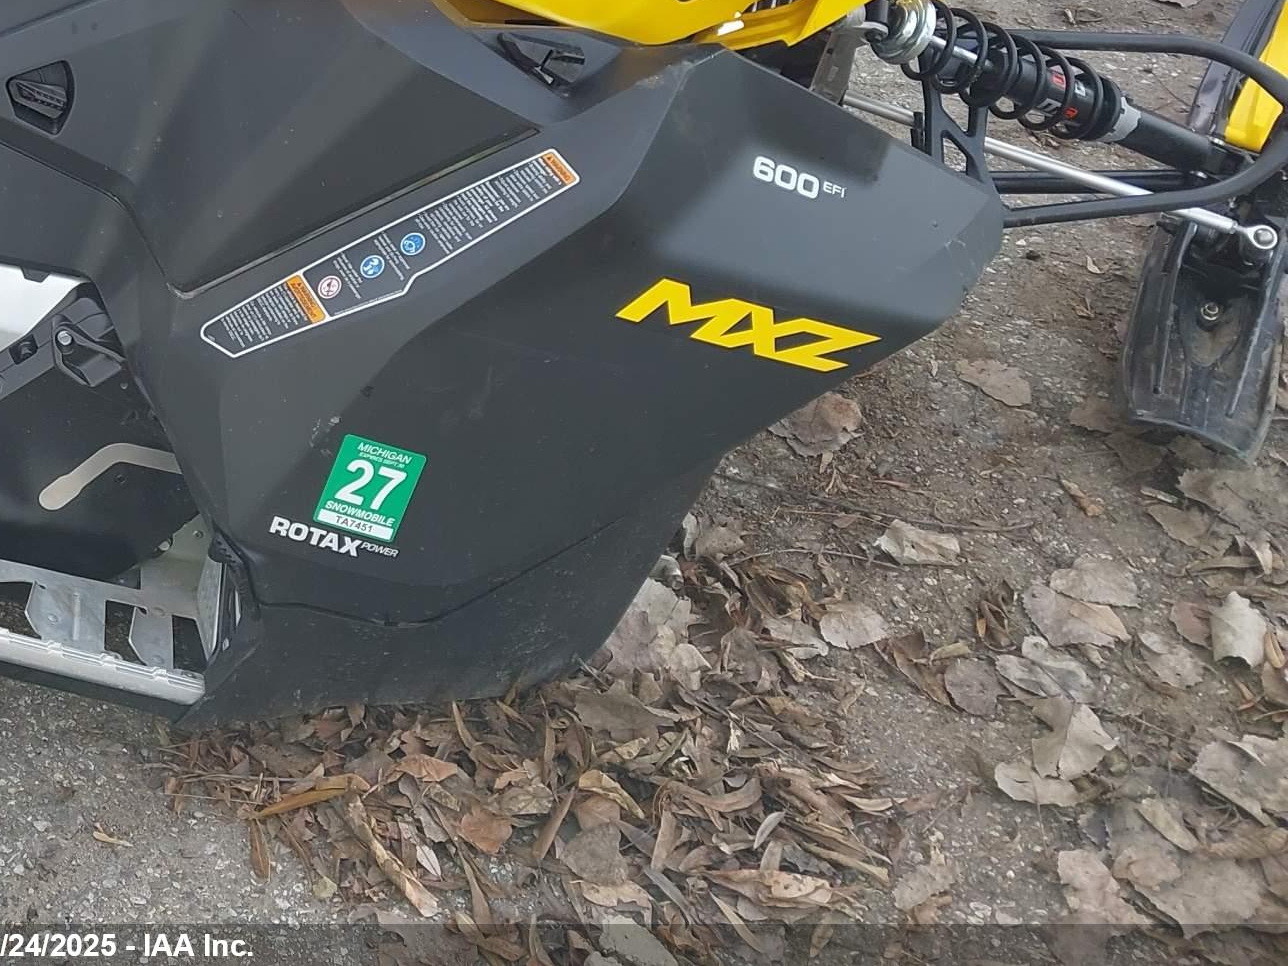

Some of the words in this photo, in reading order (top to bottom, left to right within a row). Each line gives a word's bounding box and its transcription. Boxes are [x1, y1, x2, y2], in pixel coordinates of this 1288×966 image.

[753, 155, 820, 199] 600
[822, 180, 847, 199] EFI
[615, 277, 882, 373] MXZ
[357, 442, 412, 465] MICHIGAN
[334, 459, 408, 511] 27
[325, 500, 396, 527] SNOWMOBILE
[269, 516, 363, 557] ROTAX
[360, 541, 399, 558] POWER
